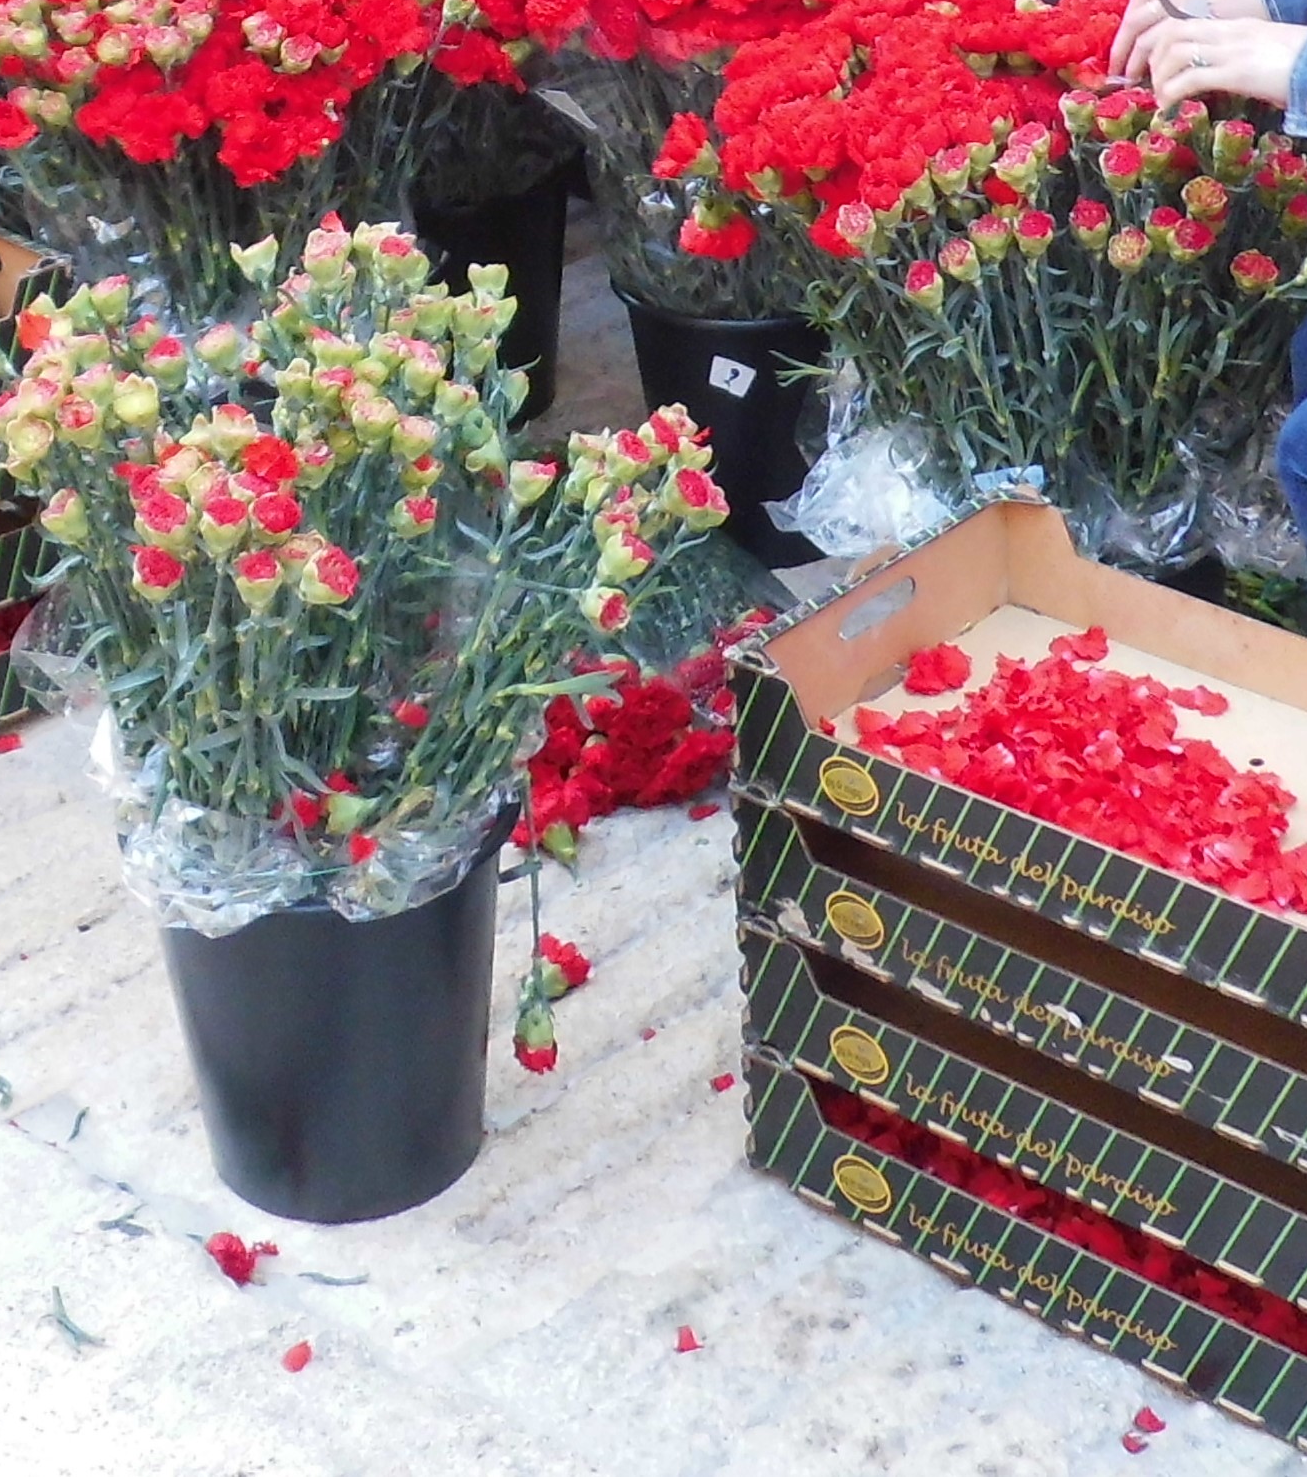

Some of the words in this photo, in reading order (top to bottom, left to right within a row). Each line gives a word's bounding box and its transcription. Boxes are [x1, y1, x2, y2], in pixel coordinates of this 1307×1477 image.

[897, 802, 930, 834] la
[932, 818, 1008, 865] fruta
[1010, 851, 1058, 886] del
[1061, 874, 1177, 935] paraiso
[902, 937, 933, 969] la
[935, 955, 1009, 1004] fruta
[1064, 1023, 1175, 1077] paraiso
[906, 1073, 936, 1103] la
[940, 1091, 1012, 1139] fruta
[1016, 1128, 1063, 1162] del
[1066, 1152, 1178, 1216] paraiso
[908, 1203, 939, 1234] la
[943, 1223, 1014, 1272] fruta
[1018, 1265, 1064, 1296] del
[1066, 1285, 1178, 1351] paraiso
